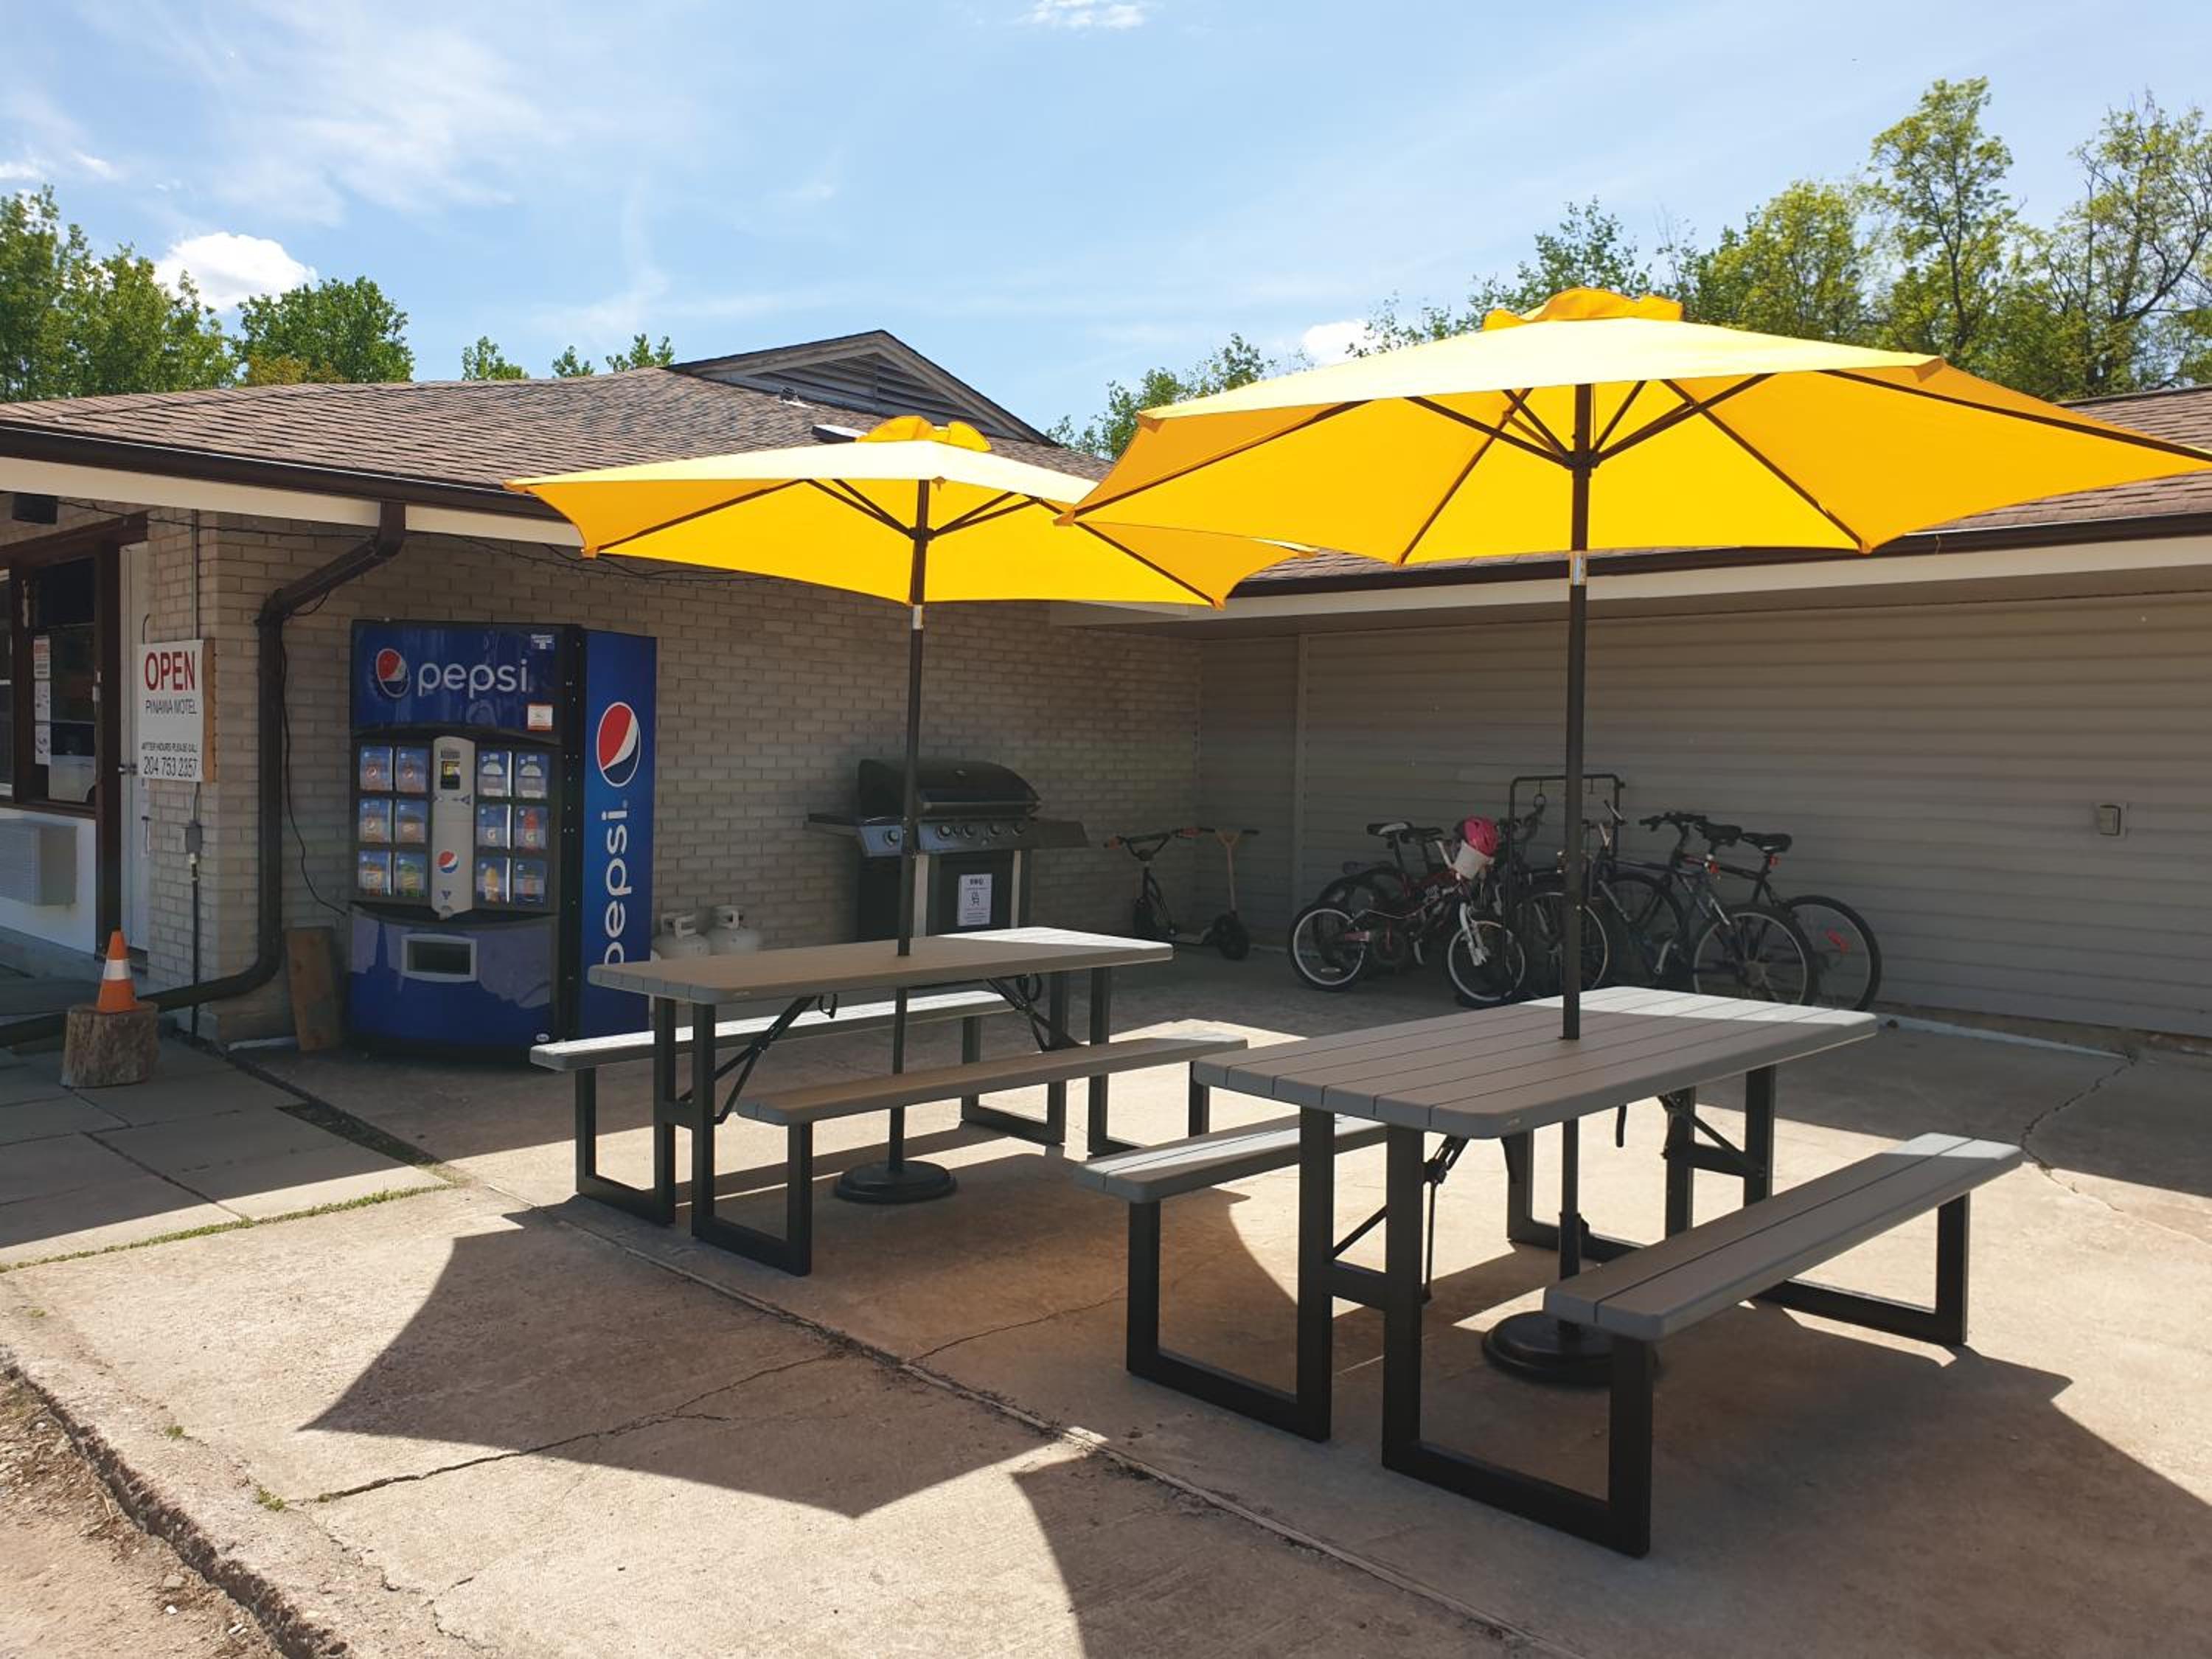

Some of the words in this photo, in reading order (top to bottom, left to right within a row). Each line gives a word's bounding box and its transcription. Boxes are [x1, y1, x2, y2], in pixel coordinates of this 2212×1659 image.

[145, 651, 195, 691] OPEN
[418, 659, 527, 698] pepsi
[174, 698, 197, 714] MOTEL
[144, 756, 159, 775] 204
[161, 757, 175, 776] 753
